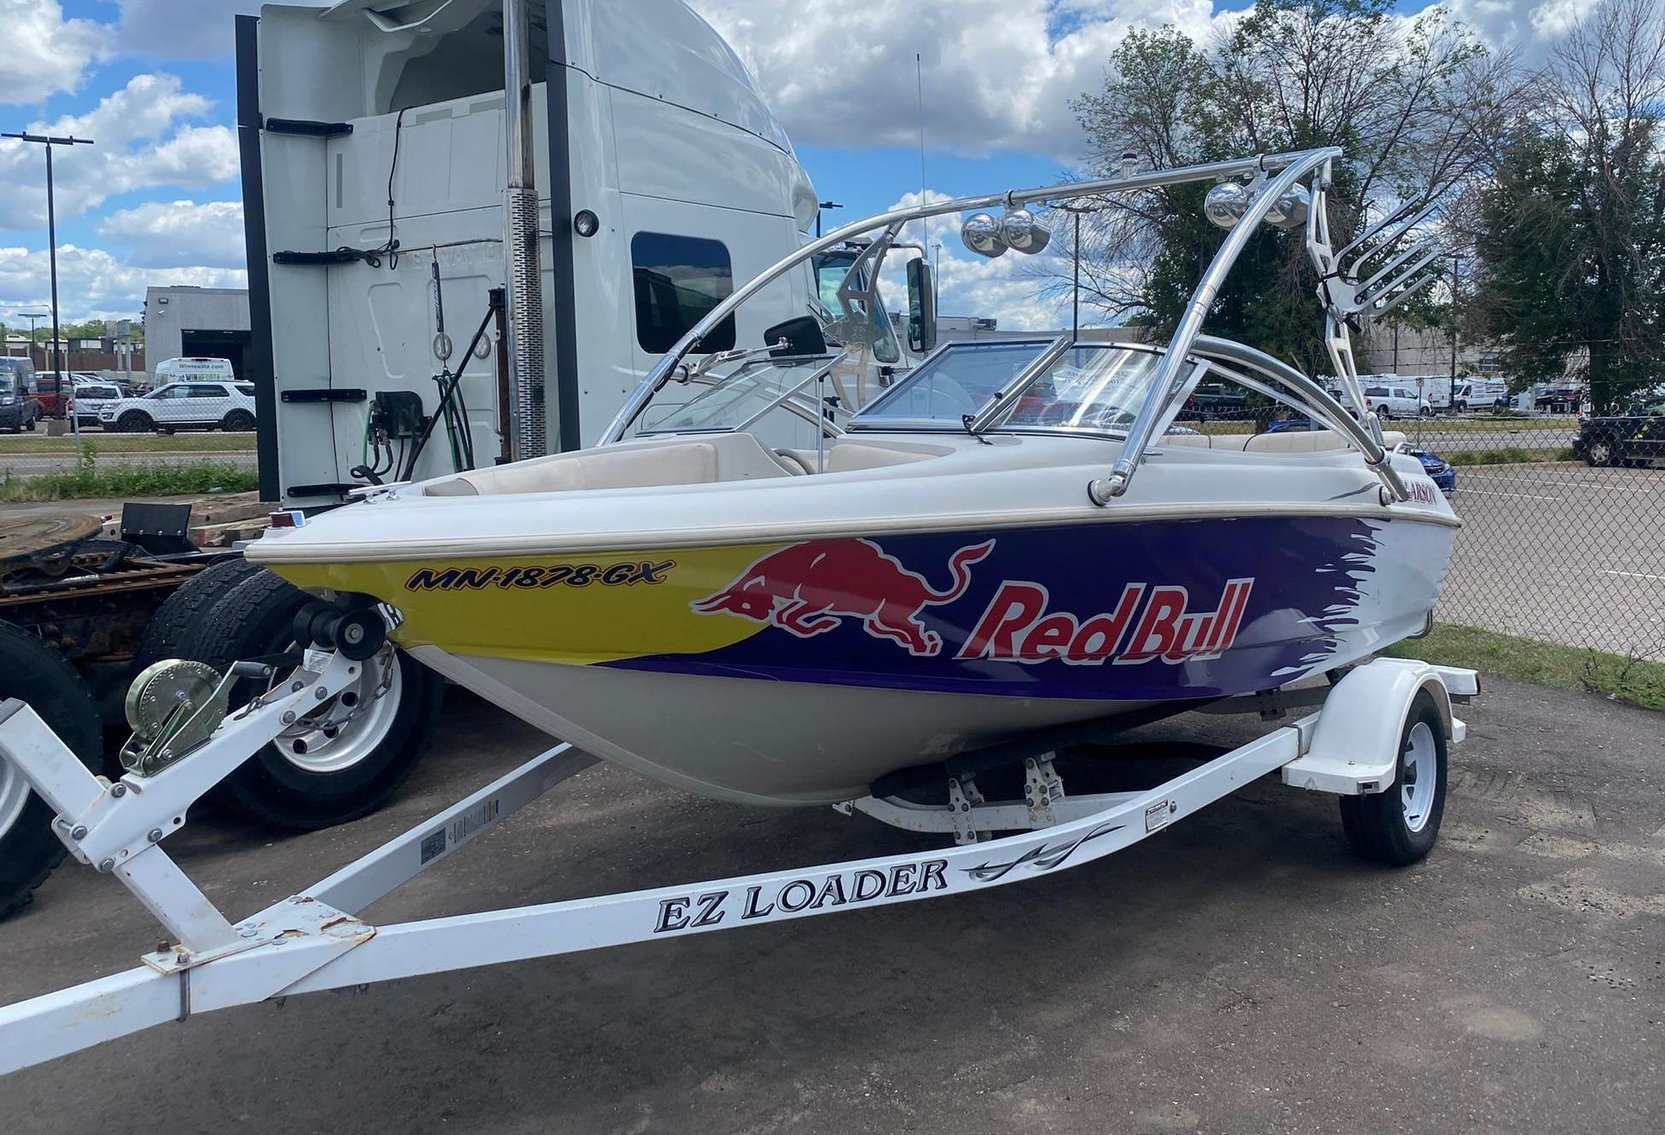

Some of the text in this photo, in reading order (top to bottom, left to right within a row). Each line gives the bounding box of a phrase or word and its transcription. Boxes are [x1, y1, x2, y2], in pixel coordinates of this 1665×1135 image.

[952, 577, 1255, 665] Red Bull
[653, 859, 949, 933] EZ LOADER
